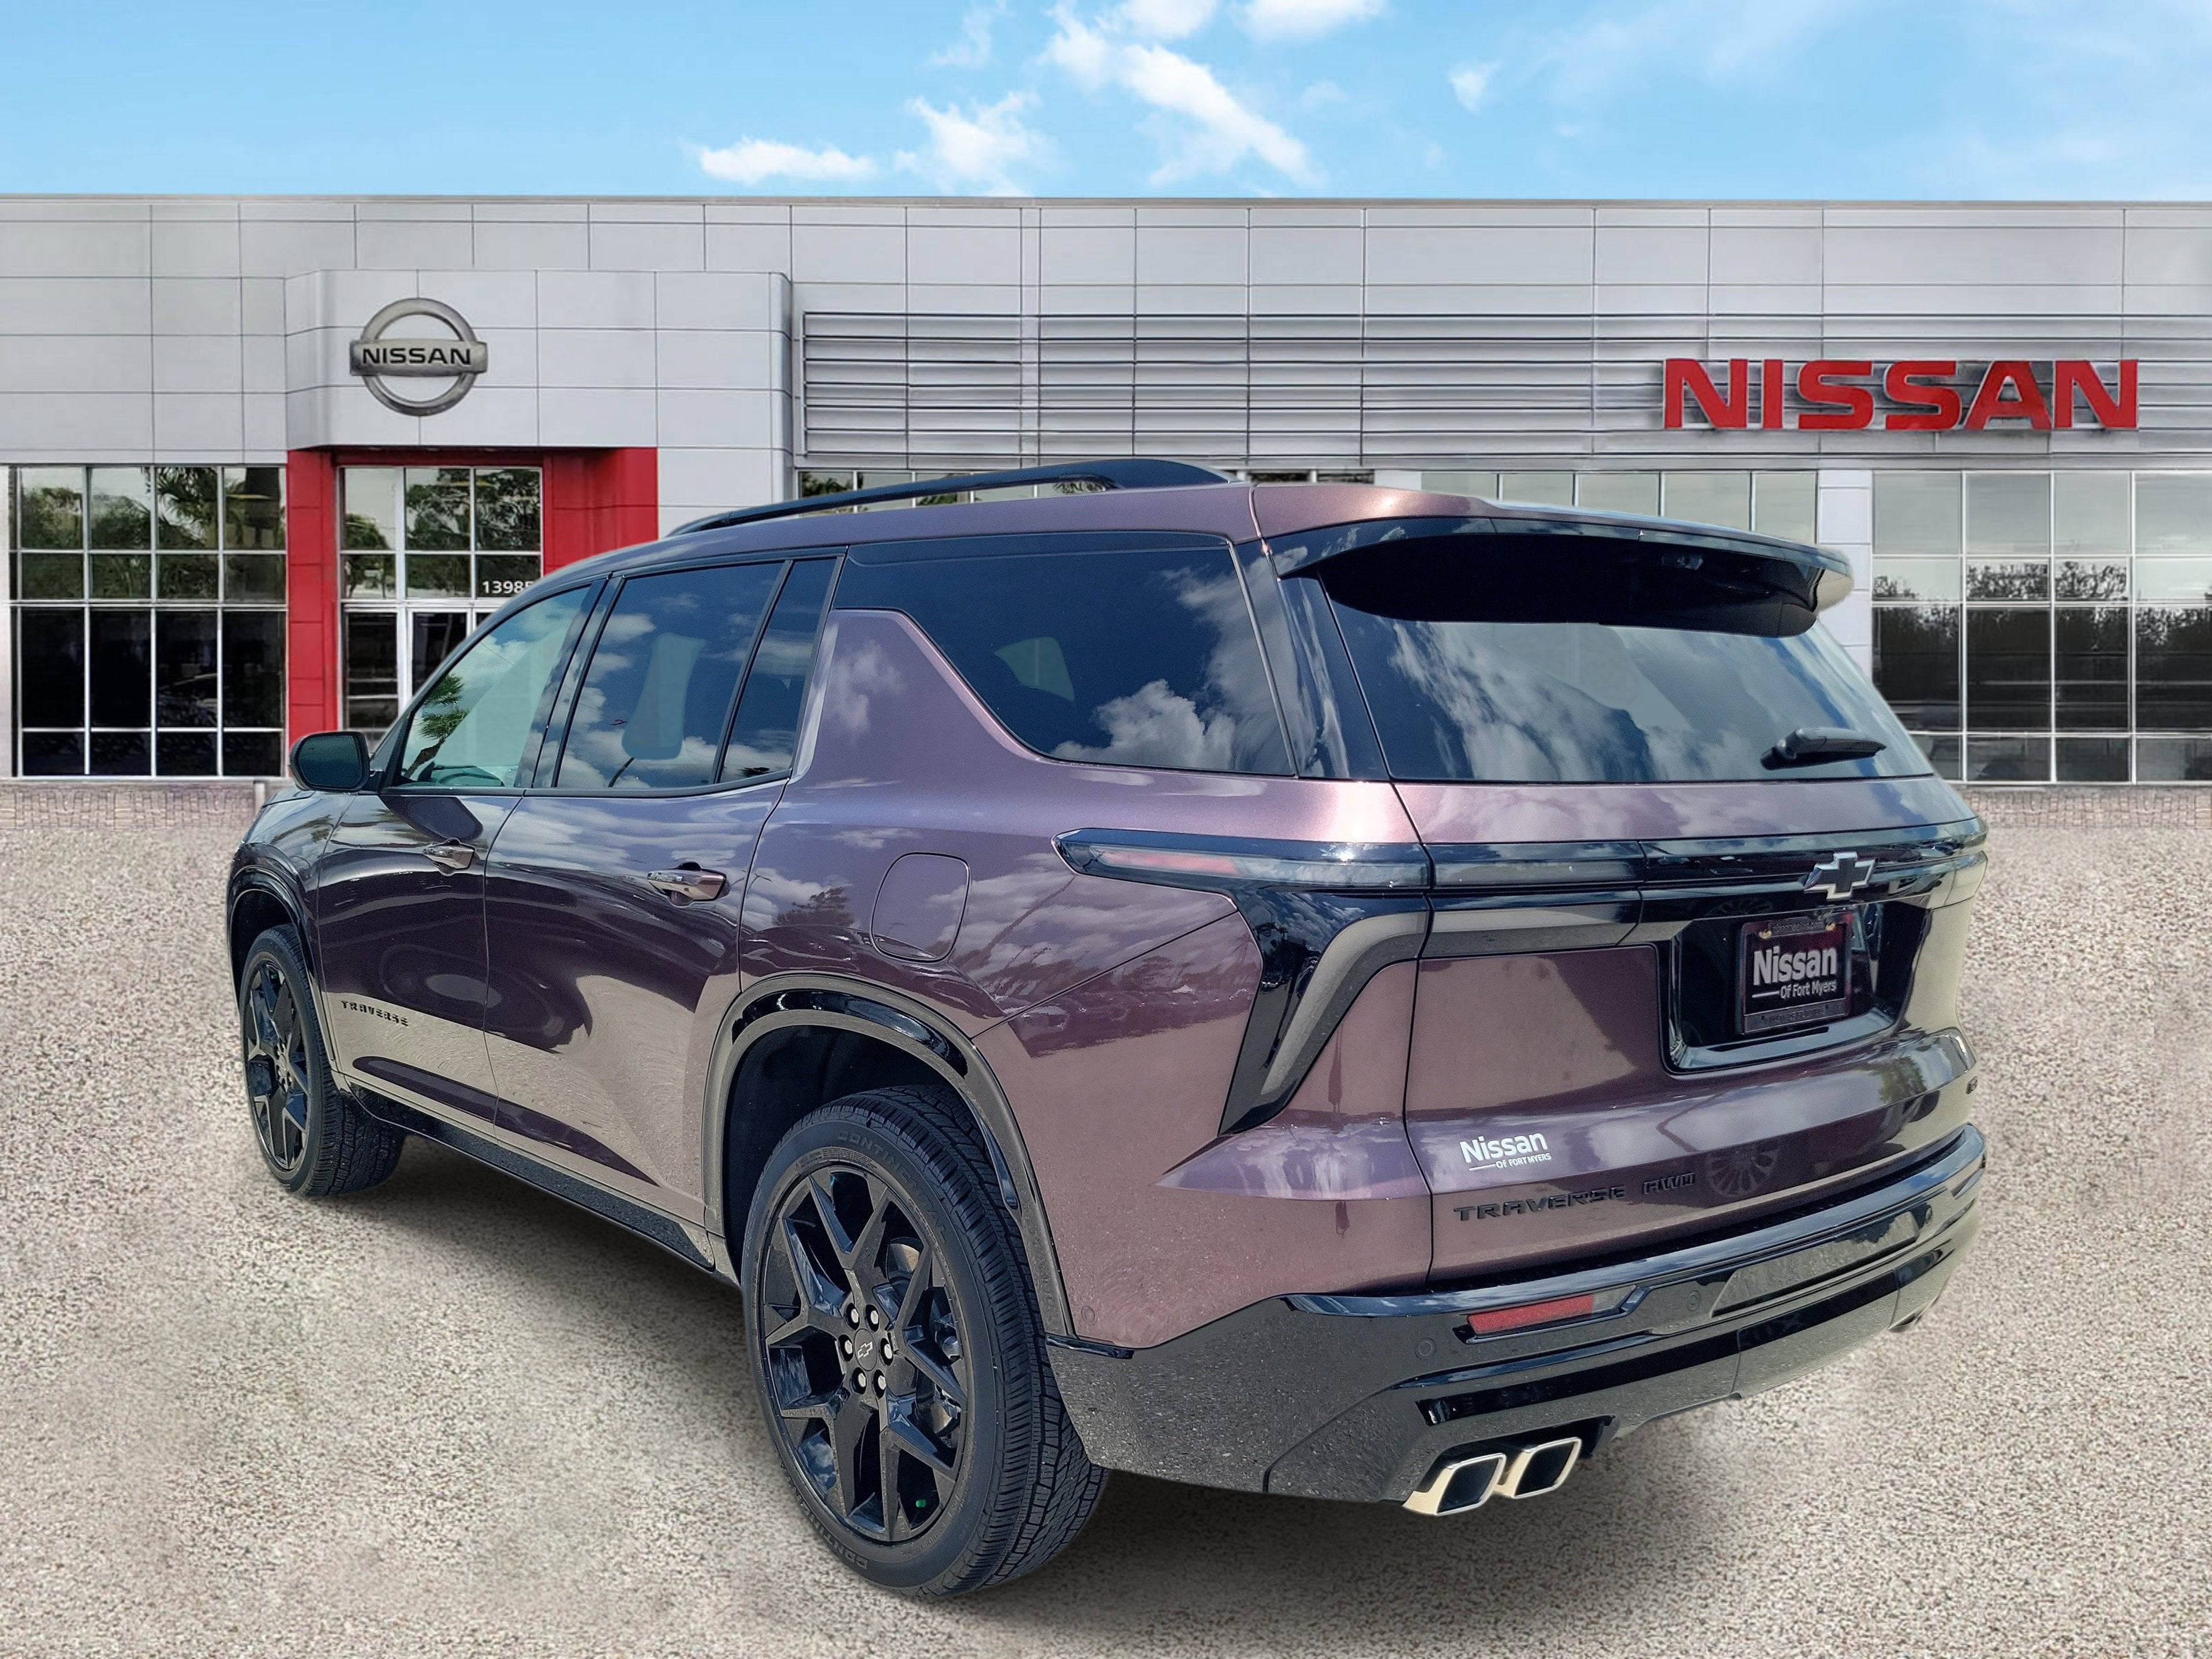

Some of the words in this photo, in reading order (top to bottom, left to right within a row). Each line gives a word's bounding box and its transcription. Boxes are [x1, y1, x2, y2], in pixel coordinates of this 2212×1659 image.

[363, 348, 470, 365] NISSAN
[1663, 358, 2139, 430] NISSAN
[1753, 945, 1838, 986] Nissan
[1792, 983, 1811, 997] Fort
[1811, 980, 1837, 997] Myers
[341, 1000, 409, 1026] TRAVERSE
[1459, 1133, 1548, 1164] Nissan
[1508, 1156, 1527, 1167] FORT
[1527, 1153, 1552, 1164] MYERS
[1454, 1185, 1626, 1221] TRAVERSE
[1643, 1172, 1695, 1195] AWD
